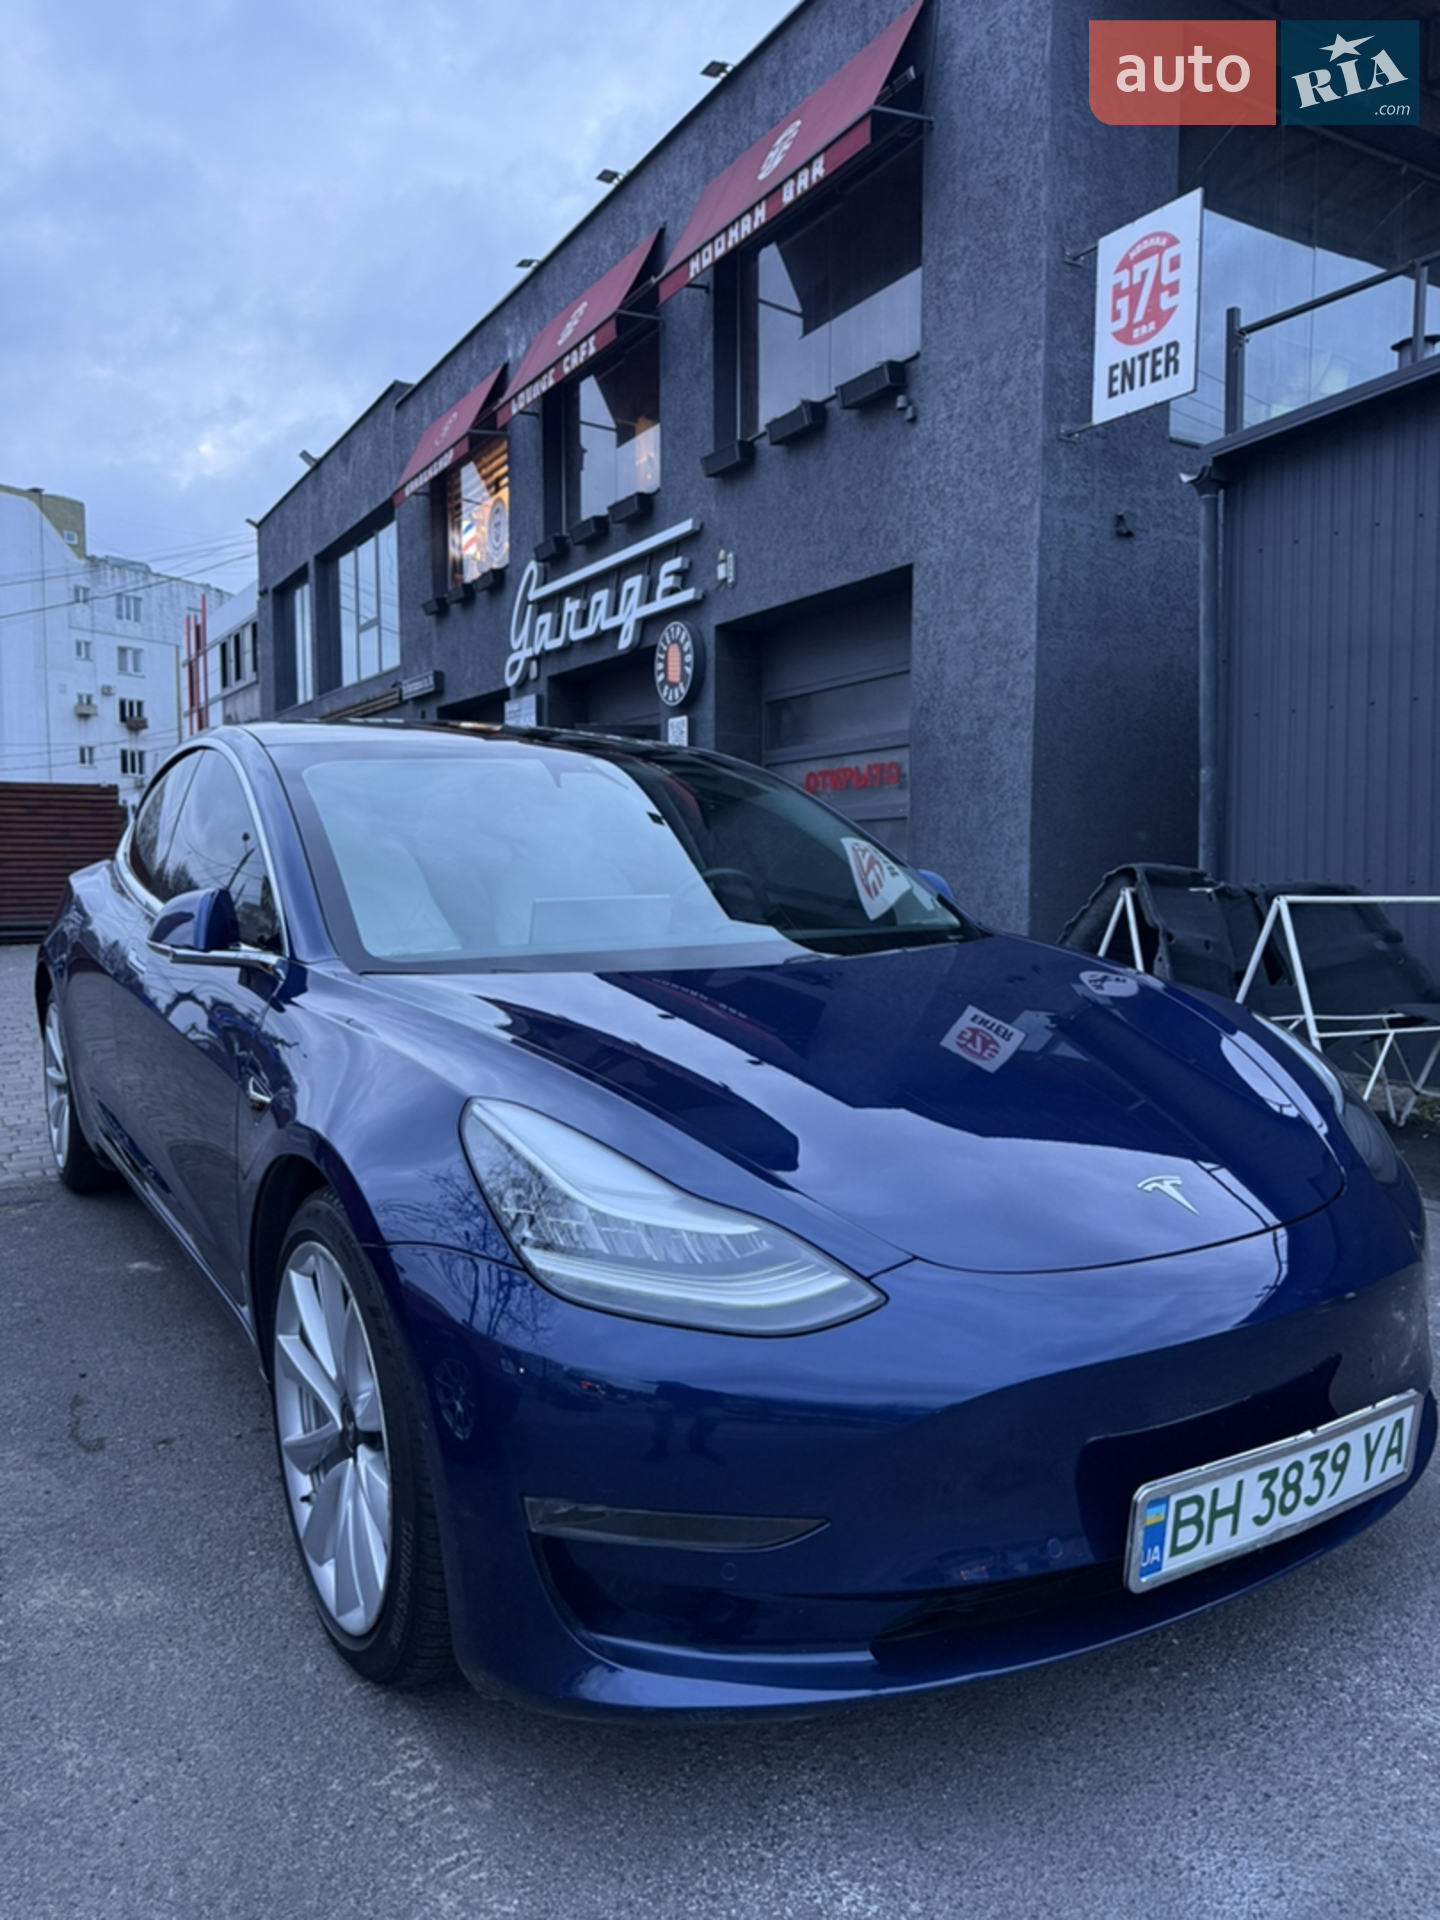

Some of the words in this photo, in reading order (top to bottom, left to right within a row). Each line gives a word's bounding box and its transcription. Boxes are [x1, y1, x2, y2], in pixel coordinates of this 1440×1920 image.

[689, 200, 767, 279] HOOKAH
[782, 153, 826, 205] BAR
[1107, 339, 1181, 399] ENTER
[803, 761, 901, 794] ОТКРЫТО
[1169, 1478, 1244, 1558] BH
[1252, 1441, 1352, 1527] 3839
[1363, 1417, 1406, 1483] YA
[1141, 1545, 1161, 1567] UA
